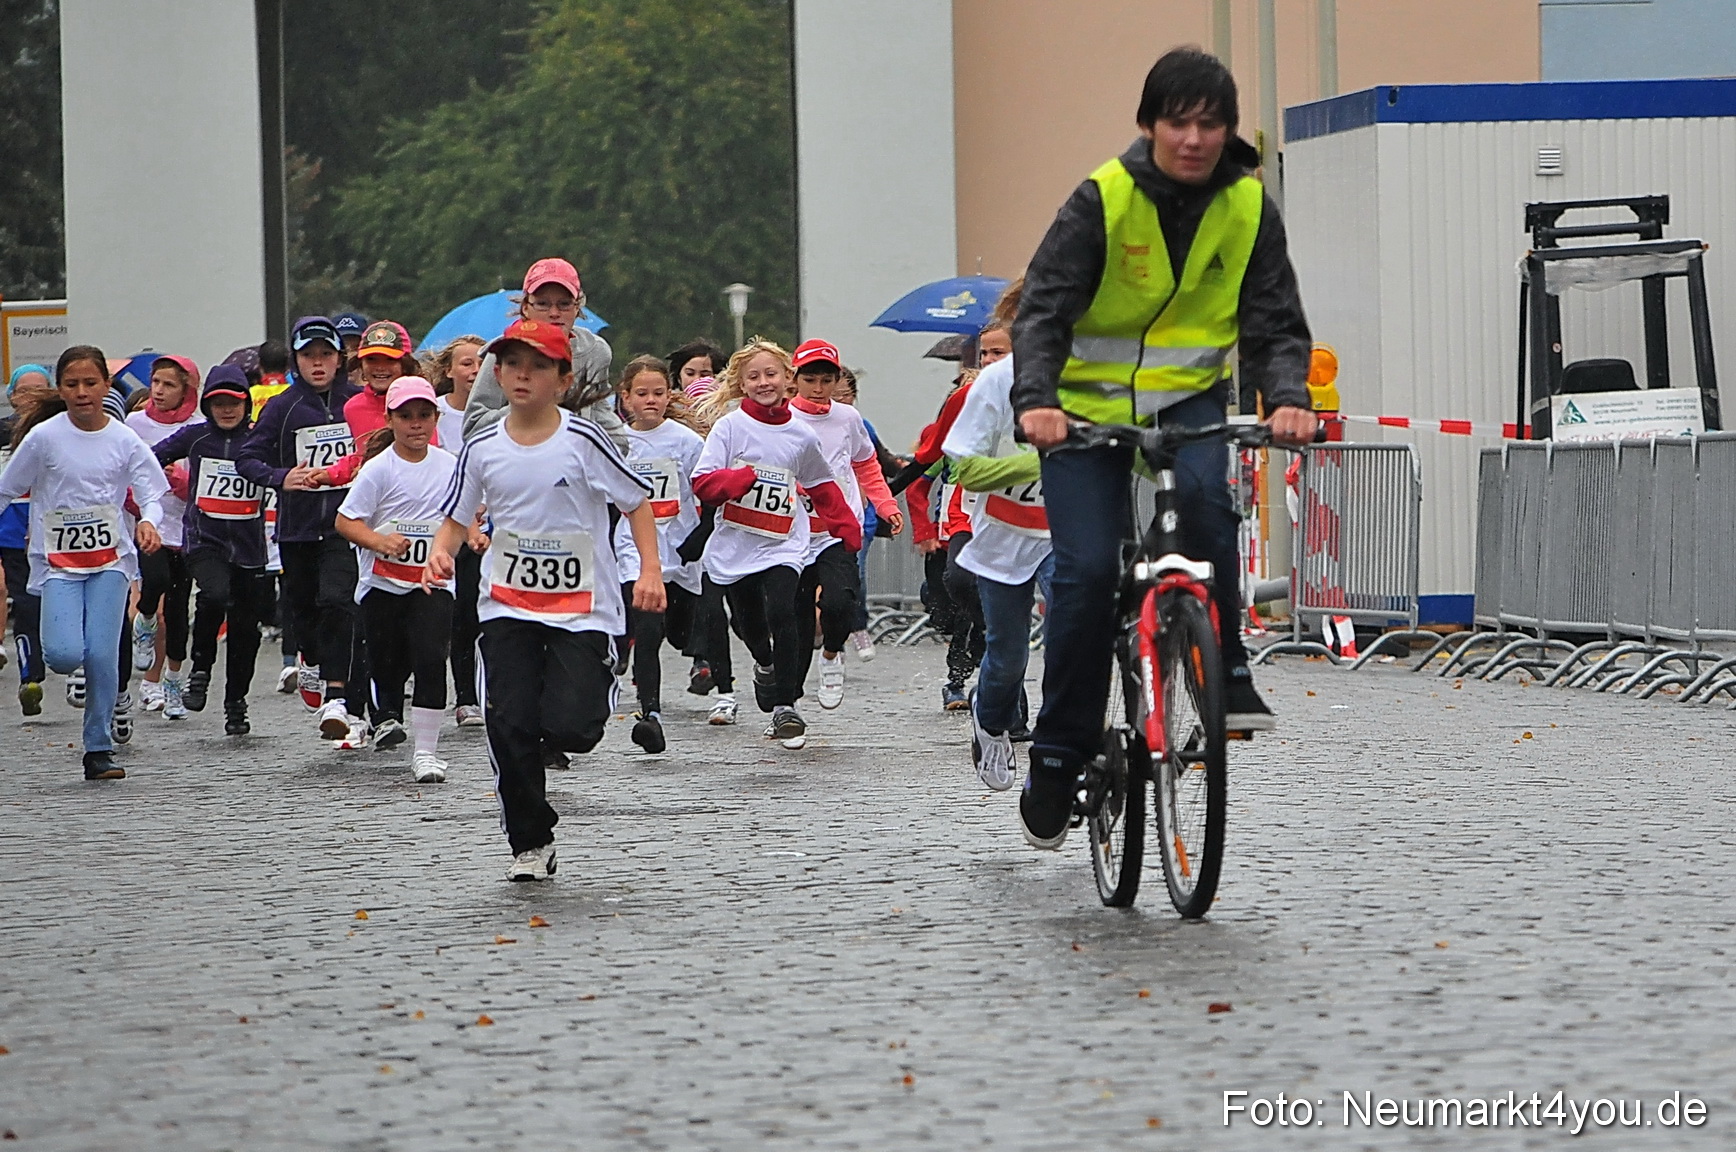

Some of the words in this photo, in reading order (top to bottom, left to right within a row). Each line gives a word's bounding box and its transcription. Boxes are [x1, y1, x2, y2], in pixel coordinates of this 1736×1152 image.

[13, 325, 68, 337] Bayerisch
[206, 474, 257, 499] 7290
[736, 484, 793, 514] 154
[52, 522, 112, 551] 7235
[503, 551, 582, 590] 7339
